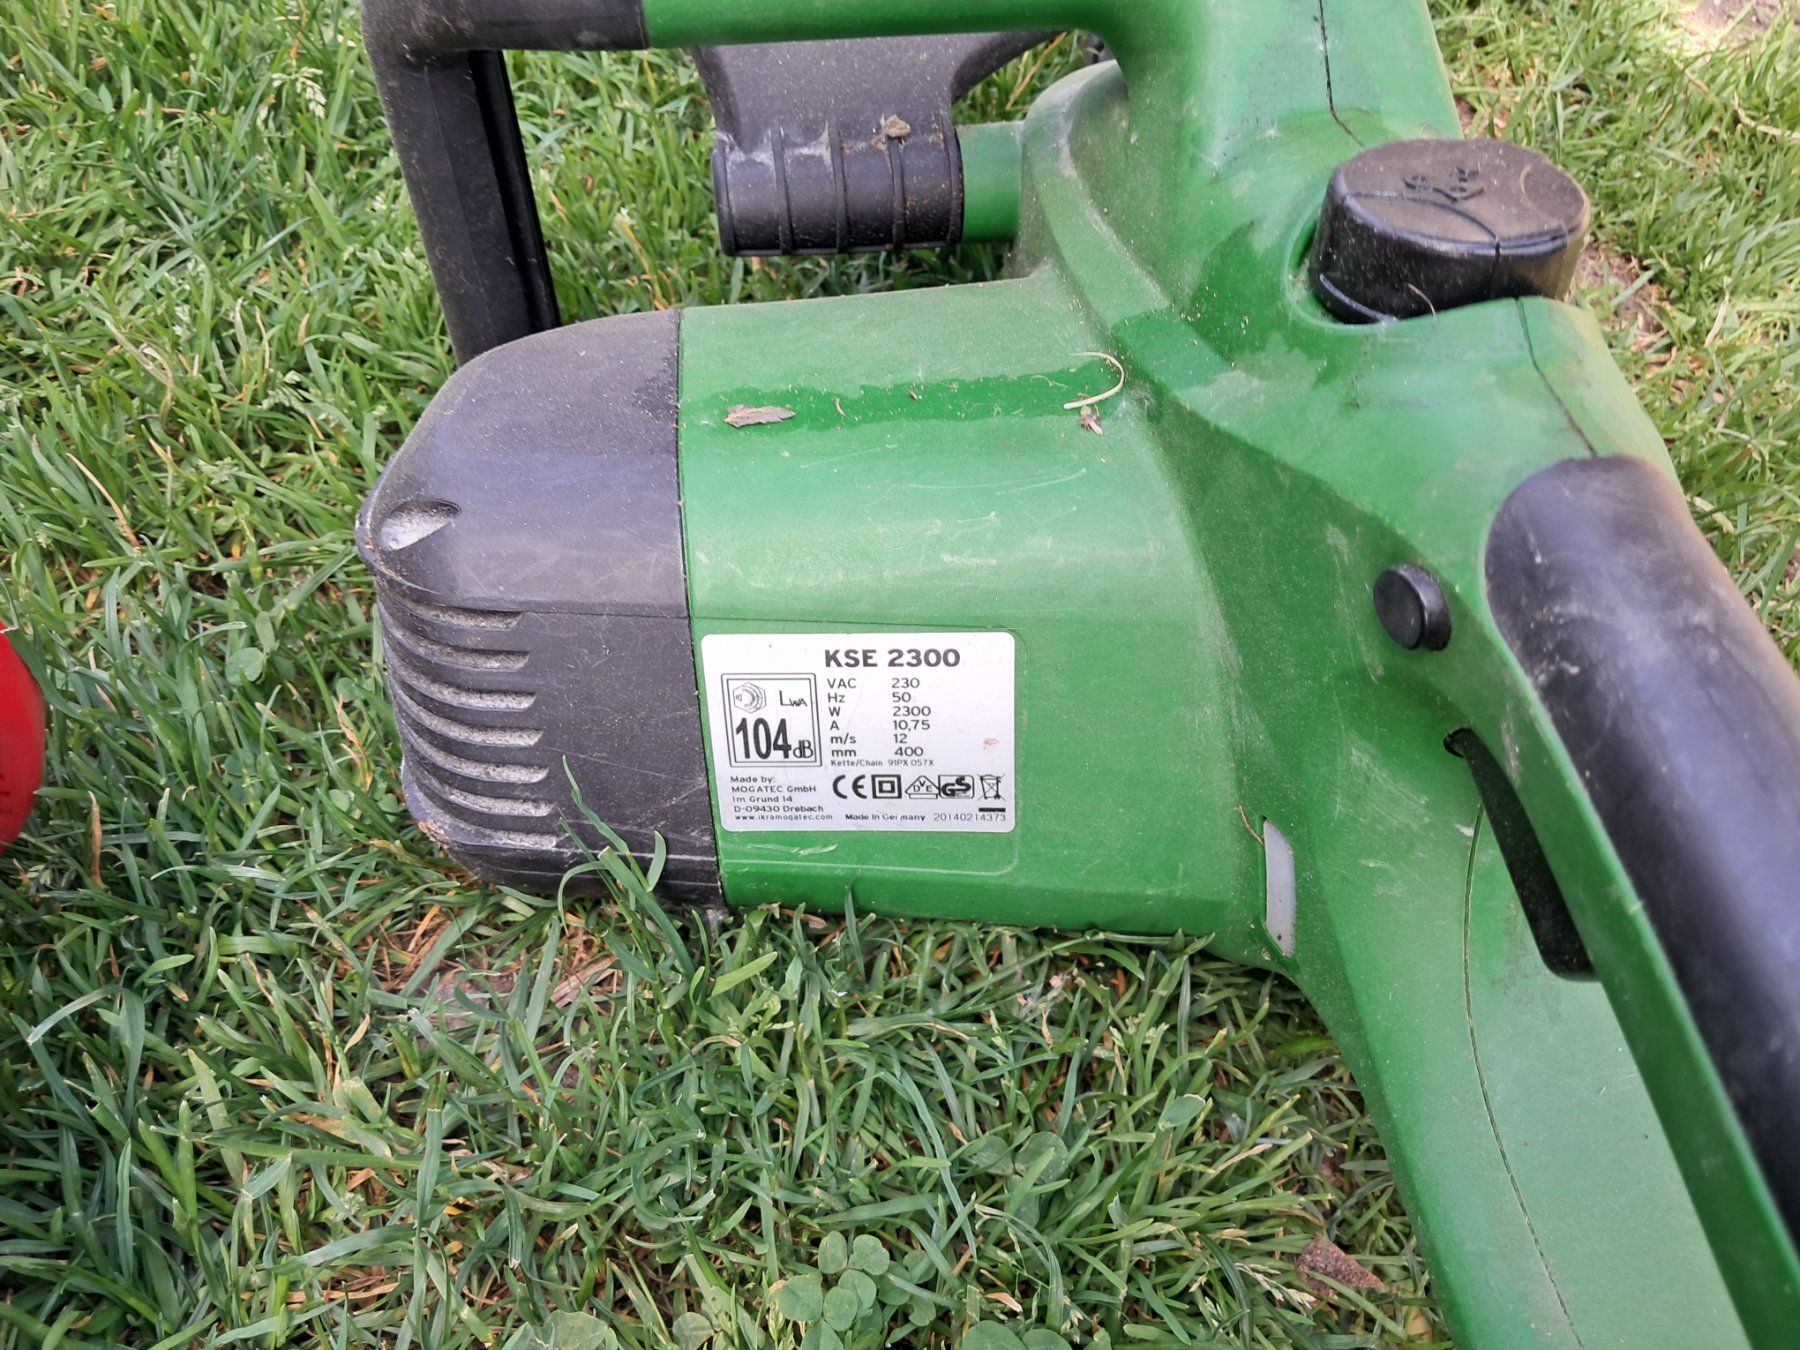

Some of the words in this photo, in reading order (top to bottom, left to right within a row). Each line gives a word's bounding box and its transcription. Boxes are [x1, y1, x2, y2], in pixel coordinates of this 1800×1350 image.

[824, 648, 878, 668] KSE
[887, 648, 961, 668] 2300
[826, 677, 857, 689] VAC
[891, 677, 920, 689] 230
[827, 692, 846, 703] Hz
[892, 691, 912, 703] 50
[828, 706, 841, 717] W
[892, 705, 932, 717] 2300
[829, 720, 840, 731] A
[892, 719, 931, 732] 10,75
[735, 717, 792, 760] 104
[792, 739, 814, 759] dB
[830, 732, 857, 745] m/s
[893, 733, 908, 744] 12
[831, 748, 857, 758] mm
[894, 746, 924, 757] 400
[830, 759, 884, 767] Kette/Chain
[887, 759, 909, 767] 91PX
[910, 759, 935, 767] 057X
[730, 775, 758, 783] Made
[760, 775, 776, 784] by:
[731, 785, 783, 793] MOGATEC
[786, 785, 817, 793] GmbH
[749, 795, 780, 803] Grund
[733, 805, 780, 813] D-09430
[782, 805, 824, 813] Drebach
[734, 814, 833, 822] www.ikramogatec.com
[844, 813, 869, 821] Made
[933, 813, 1007, 822] 20140214373
